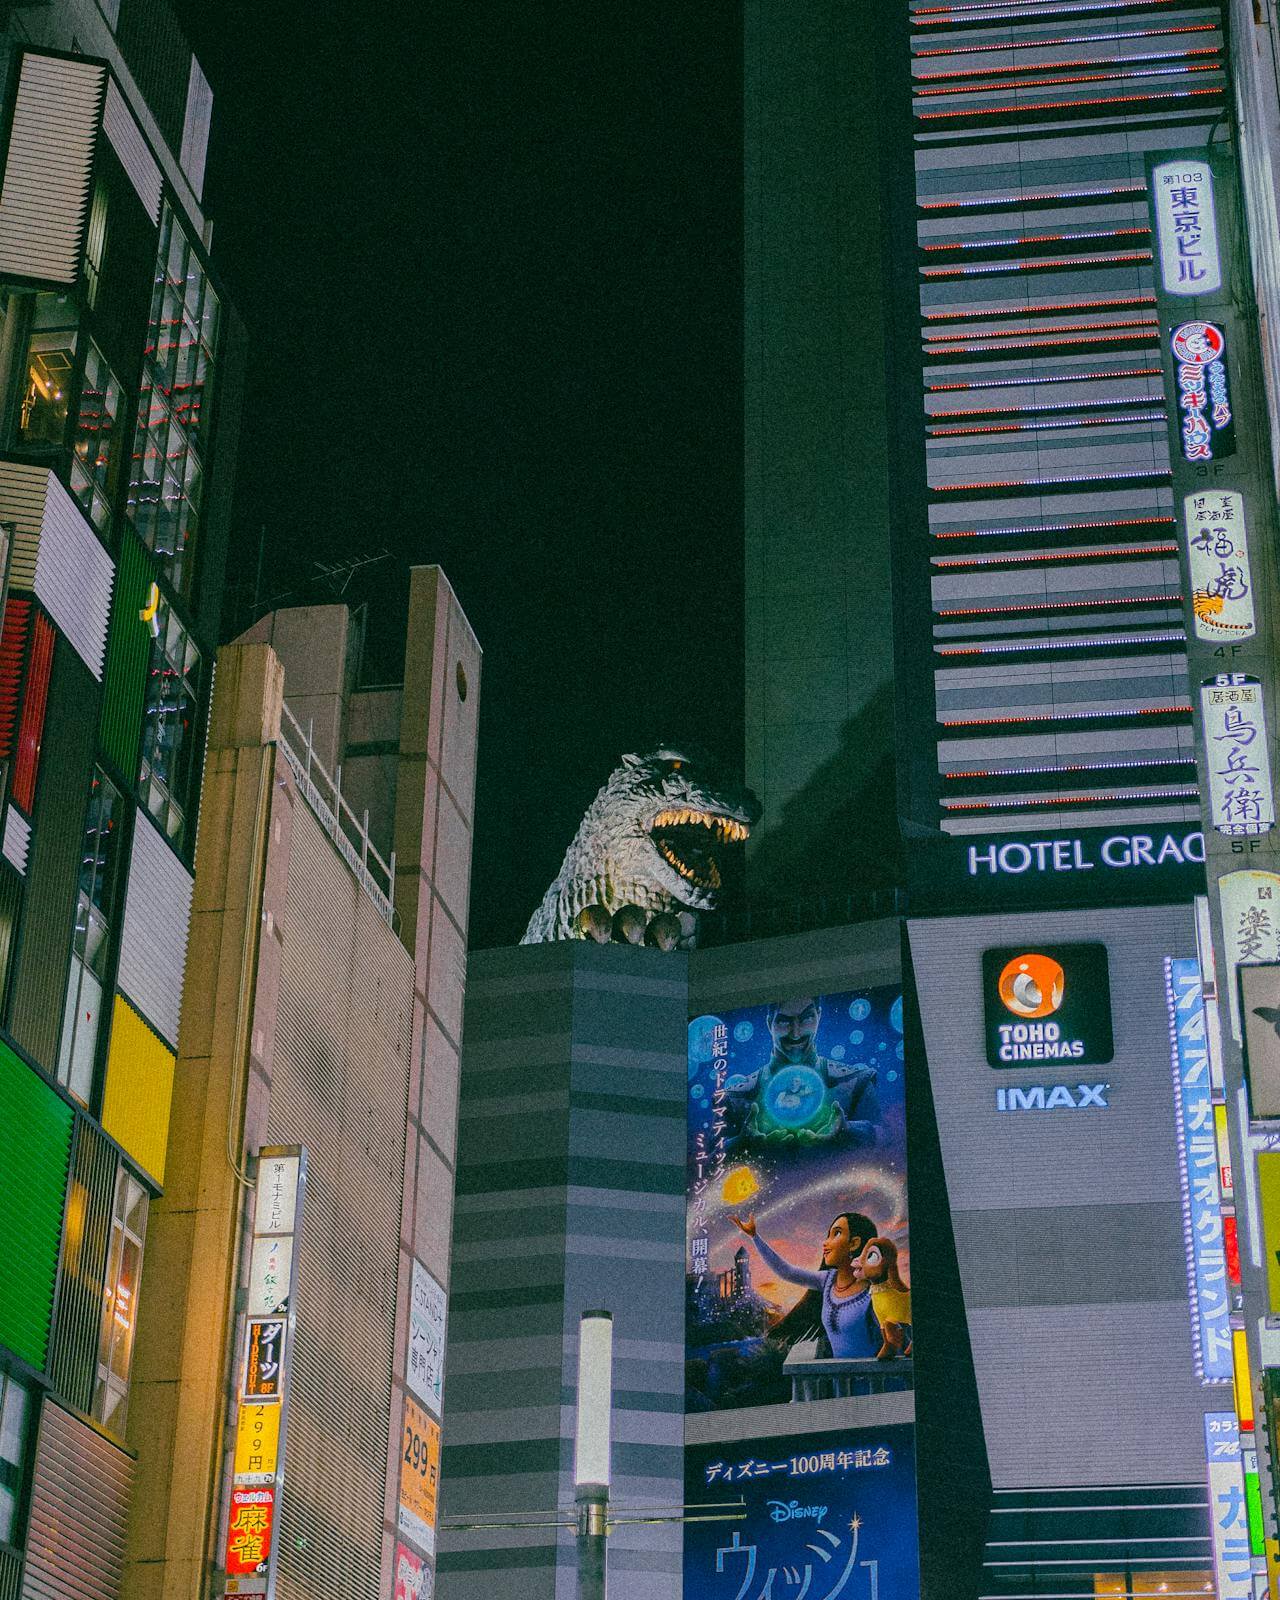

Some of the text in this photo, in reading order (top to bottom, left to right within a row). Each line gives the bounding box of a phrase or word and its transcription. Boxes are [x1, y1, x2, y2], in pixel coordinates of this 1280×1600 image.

[1163, 173, 1203, 185] 第103
[1170, 187, 1207, 282] 東京ビル
[1180, 364, 1211, 459] ミッキーハウス
[1196, 465, 1224, 477] 3F
[1213, 646, 1243, 658] 4F
[1216, 674, 1246, 687] 5F
[1212, 689, 1253, 704] 居酒屋
[1231, 840, 1261, 853] 5F
[968, 840, 1094, 875] HOTEL
[999, 1023, 1060, 1044] TOHO
[1000, 1041, 1085, 1061] CINEMAS
[711, 1024, 729, 1182] 世紀のドラマティック
[997, 1084, 1108, 1111] IMAX
[248, 1325, 261, 1395] HIDEOUT
[260, 1324, 281, 1380] ダーツ
[261, 1383, 274, 1394] 8F
[249, 1405, 264, 1470] 299円
[706, 1447, 890, 1483] ディズニー100周年記念
[234, 1492, 273, 1503] ウェルカム
[232, 1505, 268, 1562] 麻雀
[256, 1563, 268, 1572] 6F
